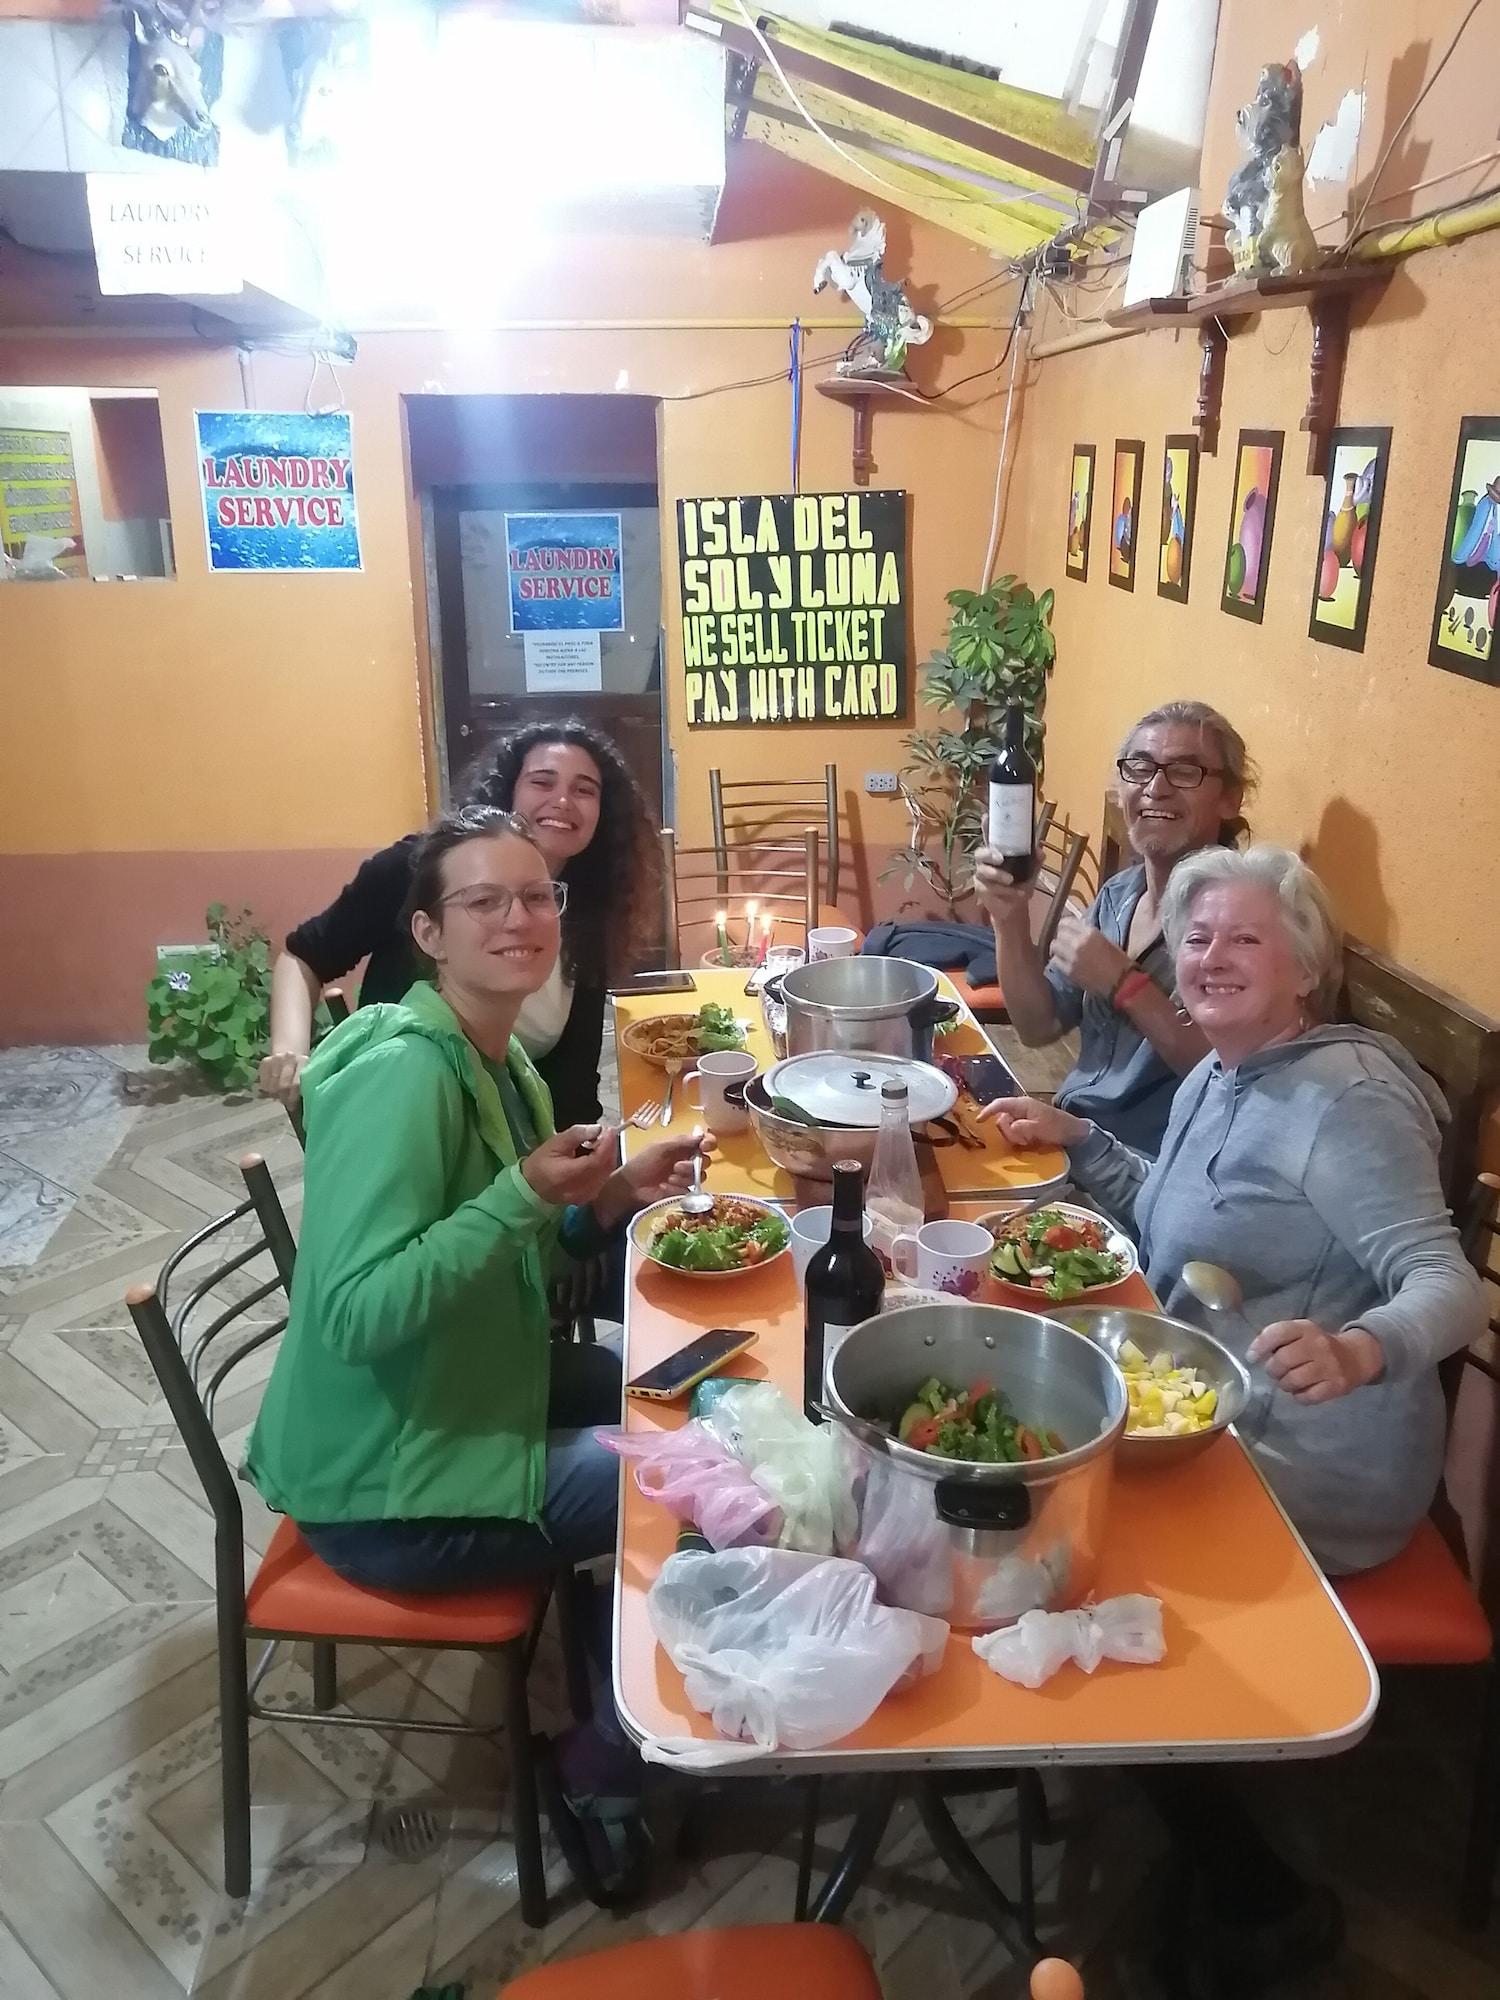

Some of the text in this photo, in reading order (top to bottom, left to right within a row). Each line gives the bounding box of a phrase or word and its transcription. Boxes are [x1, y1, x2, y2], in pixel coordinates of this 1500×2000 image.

[203, 456, 350, 489] LAUNDRY
[218, 496, 345, 527] SERVICE
[683, 495, 873, 556] ISLA DEL
[510, 547, 618, 572] LAUNDRY
[684, 551, 900, 613] SOL Y LUNA
[519, 576, 613, 600] SERVICE
[683, 609, 885, 667] WE SELL TICKET
[685, 663, 897, 723] PAY WITH CARD
